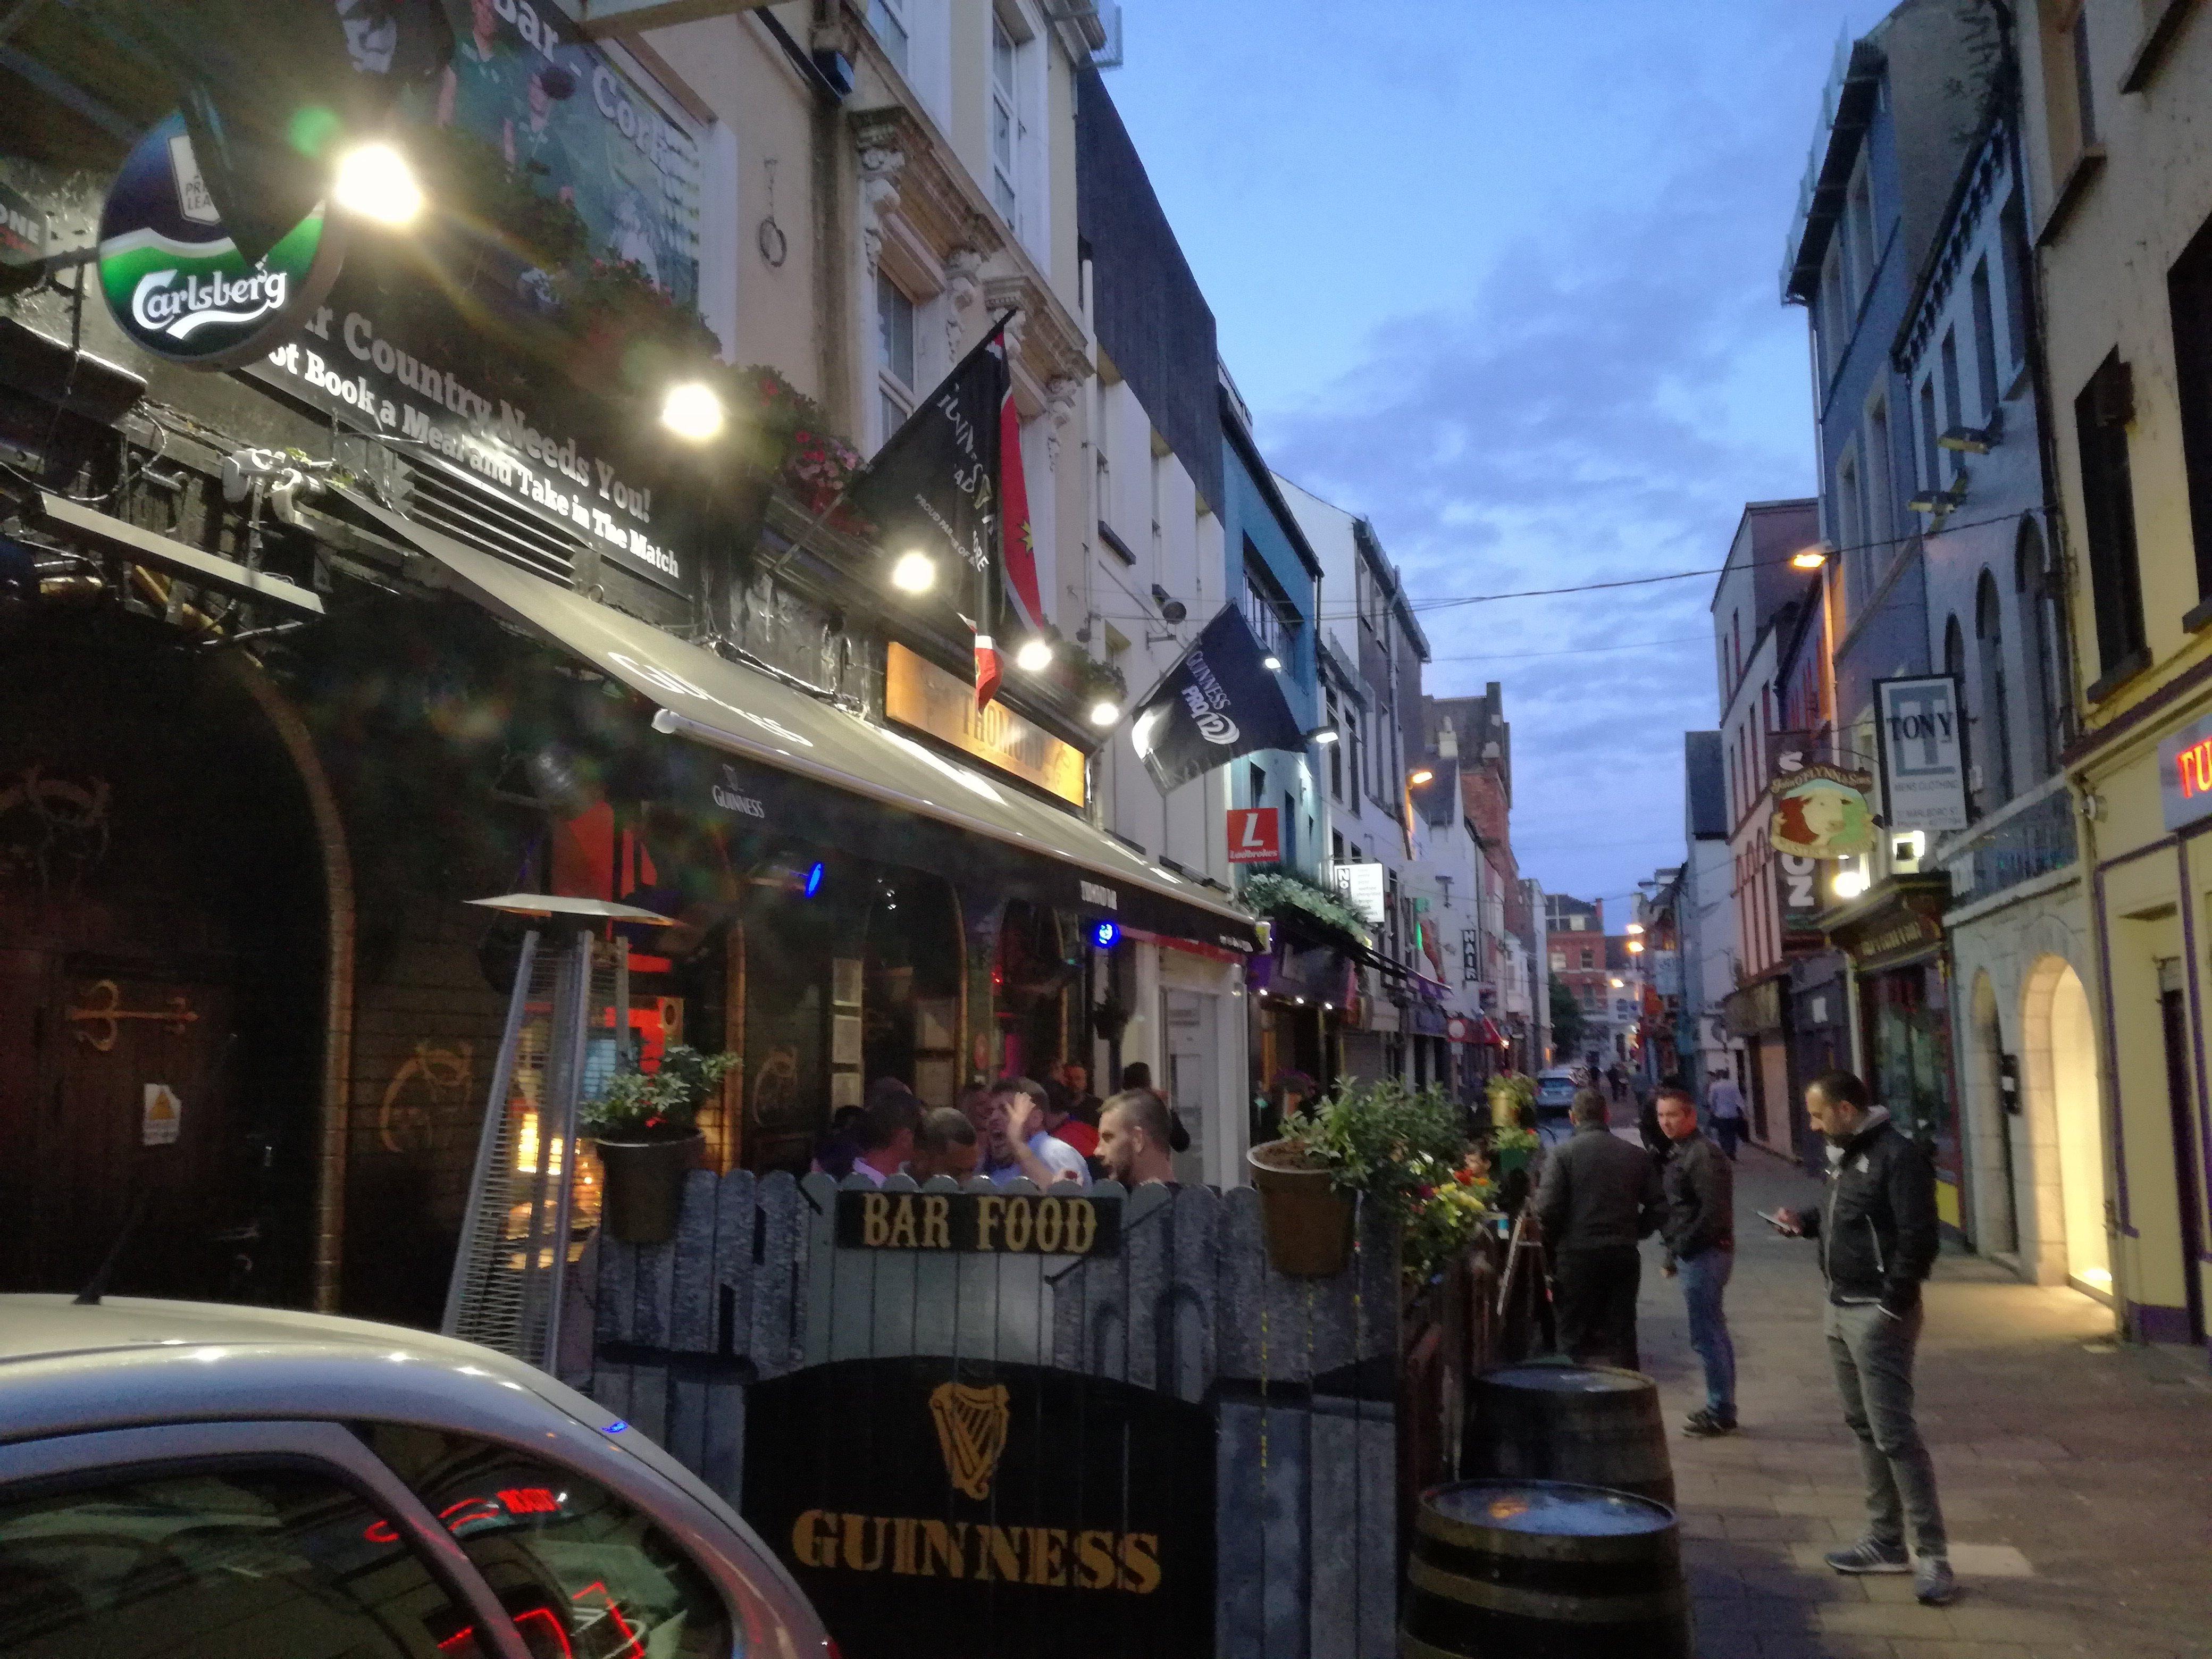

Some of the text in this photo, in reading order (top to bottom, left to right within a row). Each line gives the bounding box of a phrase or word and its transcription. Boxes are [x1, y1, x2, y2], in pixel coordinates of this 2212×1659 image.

[132, 267, 288, 331] Carlsberg
[305, 306, 652, 524] r Country Needs You!
[304, 348, 375, 415] Book
[380, 398, 396, 427] a
[402, 405, 465, 462] Meal
[468, 445, 513, 489] and
[517, 468, 569, 517] Take
[571, 494, 590, 530] in
[591, 507, 627, 548] The
[630, 530, 680, 579] Match
[916, 494, 941, 522] PROUD
[1186, 650, 1231, 710] GUINNESS
[1887, 711, 1954, 744] TONY
[711, 785, 765, 818] GUINNESS
[1242, 813, 1264, 847] L
[1229, 849, 1277, 859] Ladbrokes
[863, 1192, 1097, 1253] BAR FOOD
[792, 1508, 1162, 1595] GUINNESS
